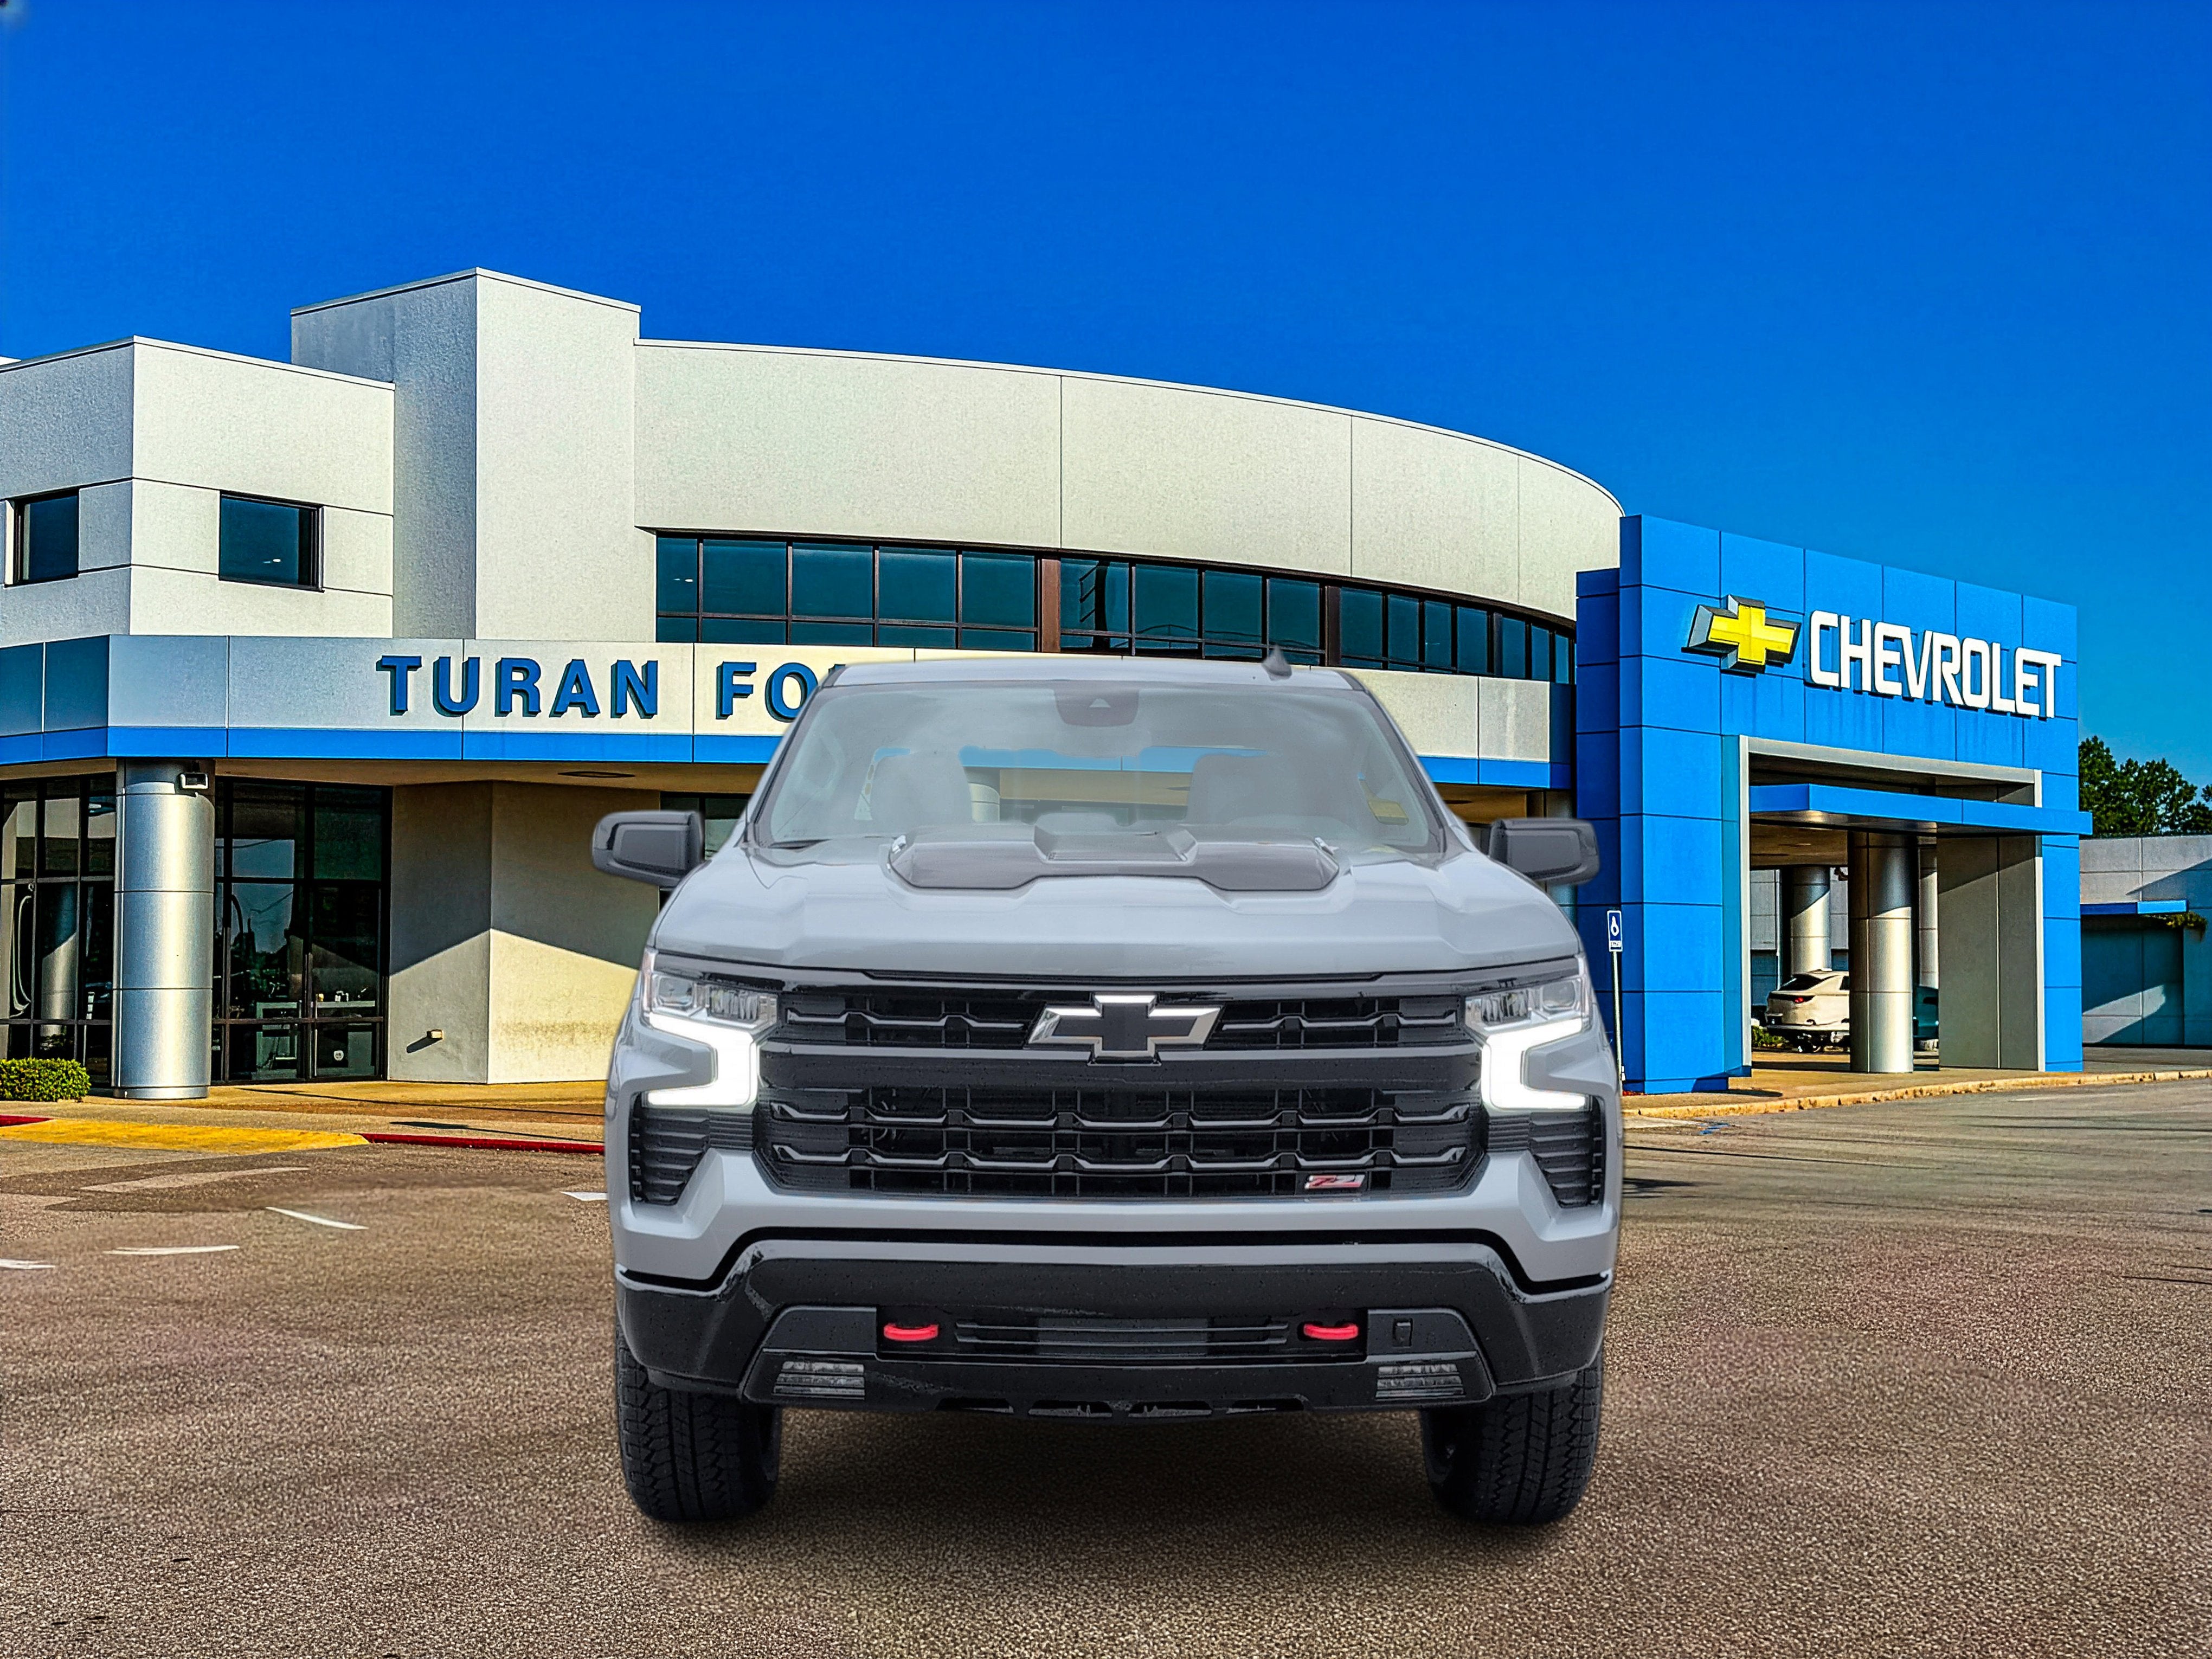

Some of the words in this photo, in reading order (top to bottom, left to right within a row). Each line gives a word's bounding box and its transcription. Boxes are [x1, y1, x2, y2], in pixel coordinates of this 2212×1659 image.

[376, 655, 659, 719] TURAN
[716, 660, 846, 723] FO
[1809, 609, 2062, 719] CHEVROLET
